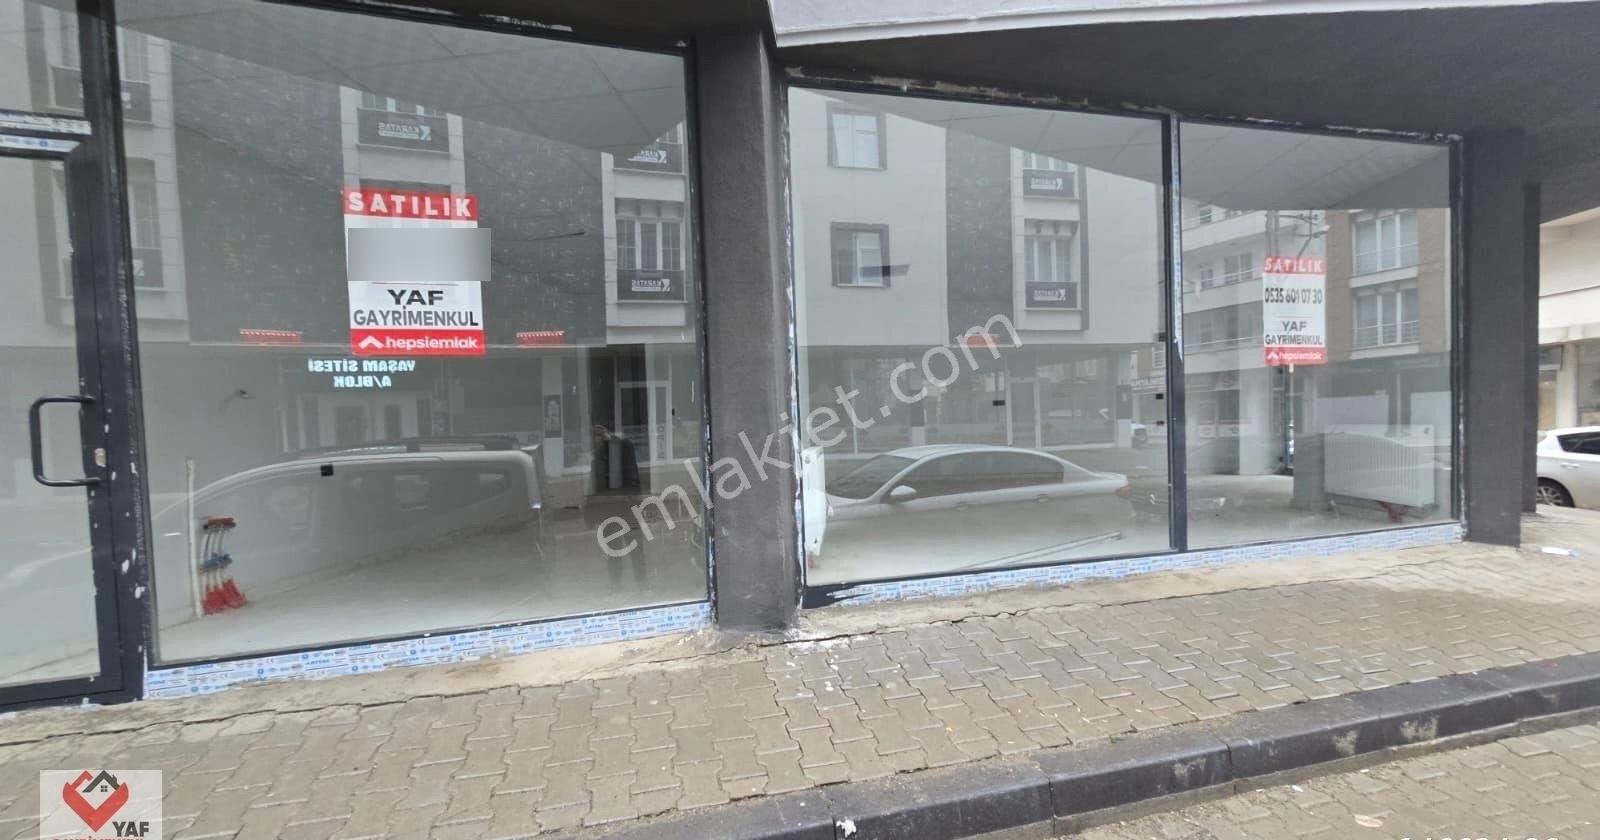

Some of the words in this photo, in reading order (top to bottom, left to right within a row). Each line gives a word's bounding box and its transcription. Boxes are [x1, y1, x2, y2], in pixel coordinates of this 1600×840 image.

[348, 191, 472, 217] SATILIK
[1264, 257, 1323, 273] SATILIK
[387, 289, 444, 306] YAF
[1264, 287, 1284, 304] 0535
[1301, 288, 1311, 304] 07
[353, 305, 479, 327] GAYRİMENKUL
[1281, 320, 1308, 332] YAF
[385, 335, 479, 351] hepsiemlak
